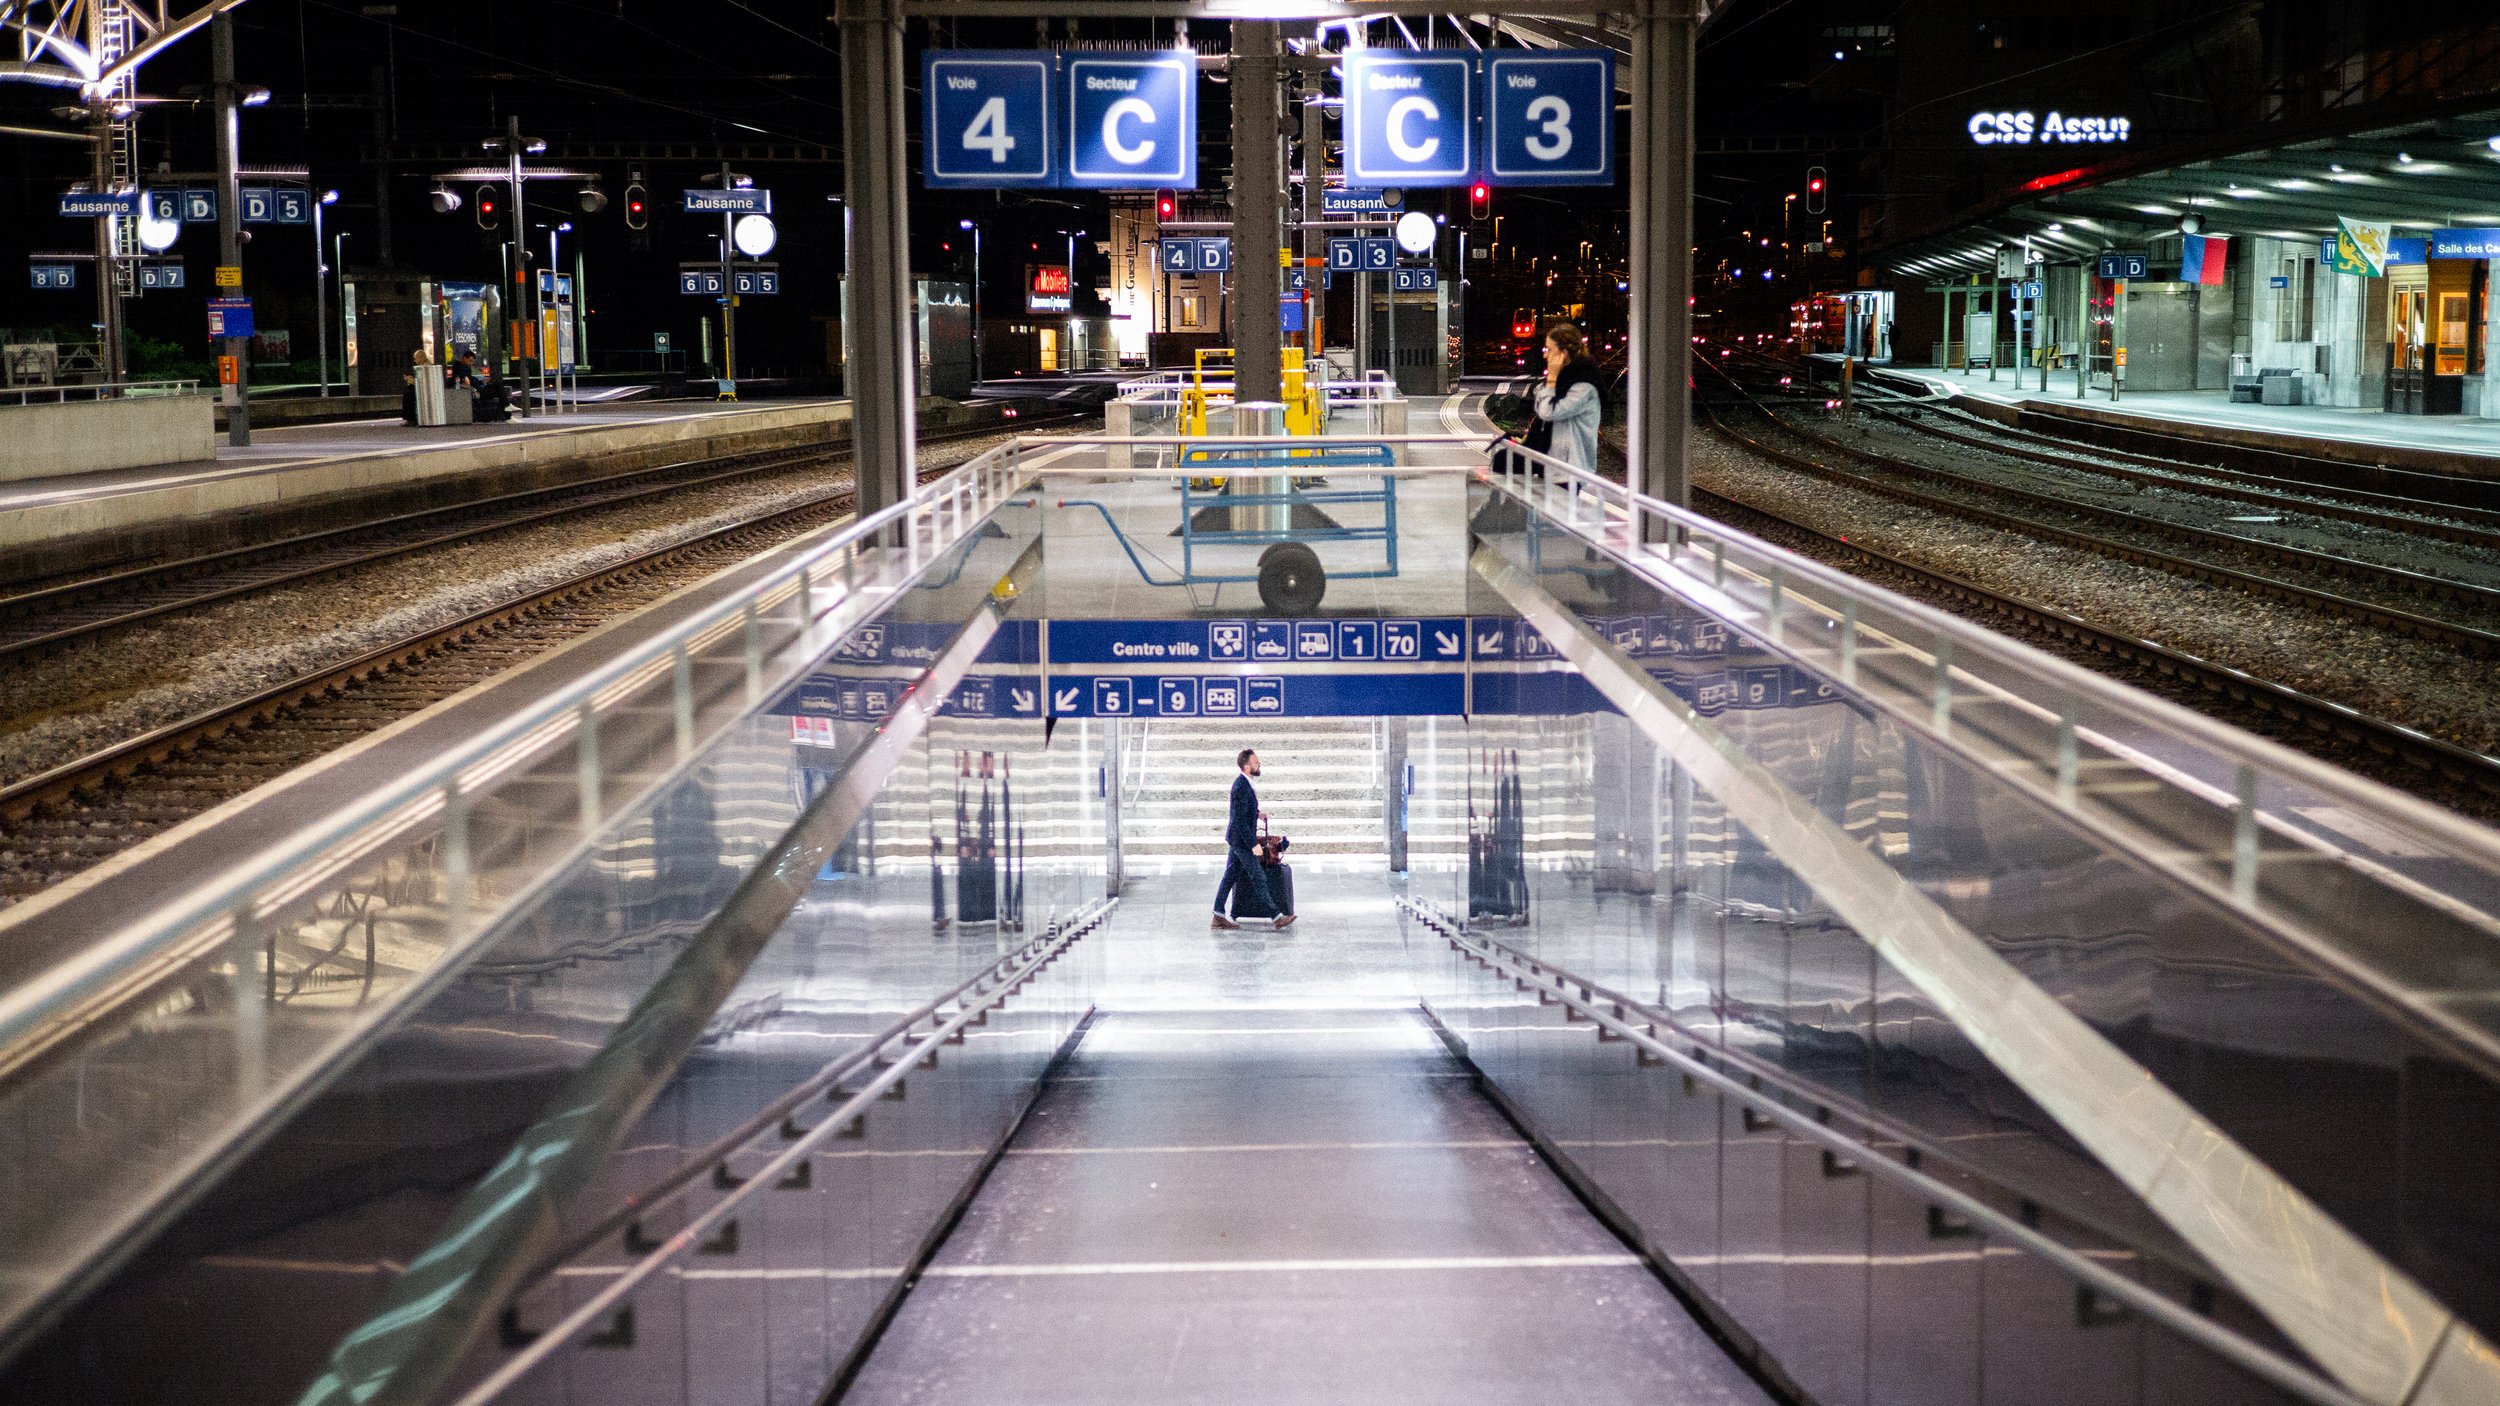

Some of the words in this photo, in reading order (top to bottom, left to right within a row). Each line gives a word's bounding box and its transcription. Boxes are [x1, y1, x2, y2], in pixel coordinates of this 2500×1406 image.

[947, 76, 977, 90] Voie
[1086, 76, 1138, 91] Secteur
[1507, 75, 1536, 89] Voie
[963, 96, 1015, 163] 4
[1102, 97, 1156, 164] C
[1386, 96, 1440, 163] C
[1524, 95, 1573, 160] 3
[1968, 111, 2034, 144] CSS
[62, 200, 130, 213] Lausanne
[159, 200, 173, 218] 6
[194, 200, 209, 217] D
[250, 200, 265, 217] D
[286, 200, 299, 218] 5
[687, 197, 754, 209] Lausanne
[2438, 244, 2462, 253] Salle
[2465, 244, 2483, 253] des
[2485, 243, 2500, 254] Ca
[1171, 249, 1185, 267] 4
[1205, 249, 1221, 267] D
[1338, 248, 1353, 266] D
[1373, 248, 1386, 266] 3
[2107, 263, 2113, 275] 1
[2130, 263, 2140, 275] D
[37, 273, 46, 285] 8
[59, 273, 70, 285] D
[146, 273, 156, 285] D
[169, 273, 177, 285] 7
[686, 279, 696, 291] 6
[708, 279, 718, 291] D
[740, 279, 751, 291] D
[763, 279, 772, 291] 5
[1294, 275, 1304, 287] 4
[1400, 275, 1410, 287] D
[1422, 275, 1432, 287] 3
[2031, 287, 2039, 295] D
[1113, 641, 1165, 656] Centre
[1168, 641, 1200, 656] ville
[1352, 635, 1363, 655] 1
[1387, 635, 1414, 655] 70
[1105, 691, 1120, 712] 5
[1170, 691, 1185, 712] 9
[1207, 691, 1236, 706] P+R
